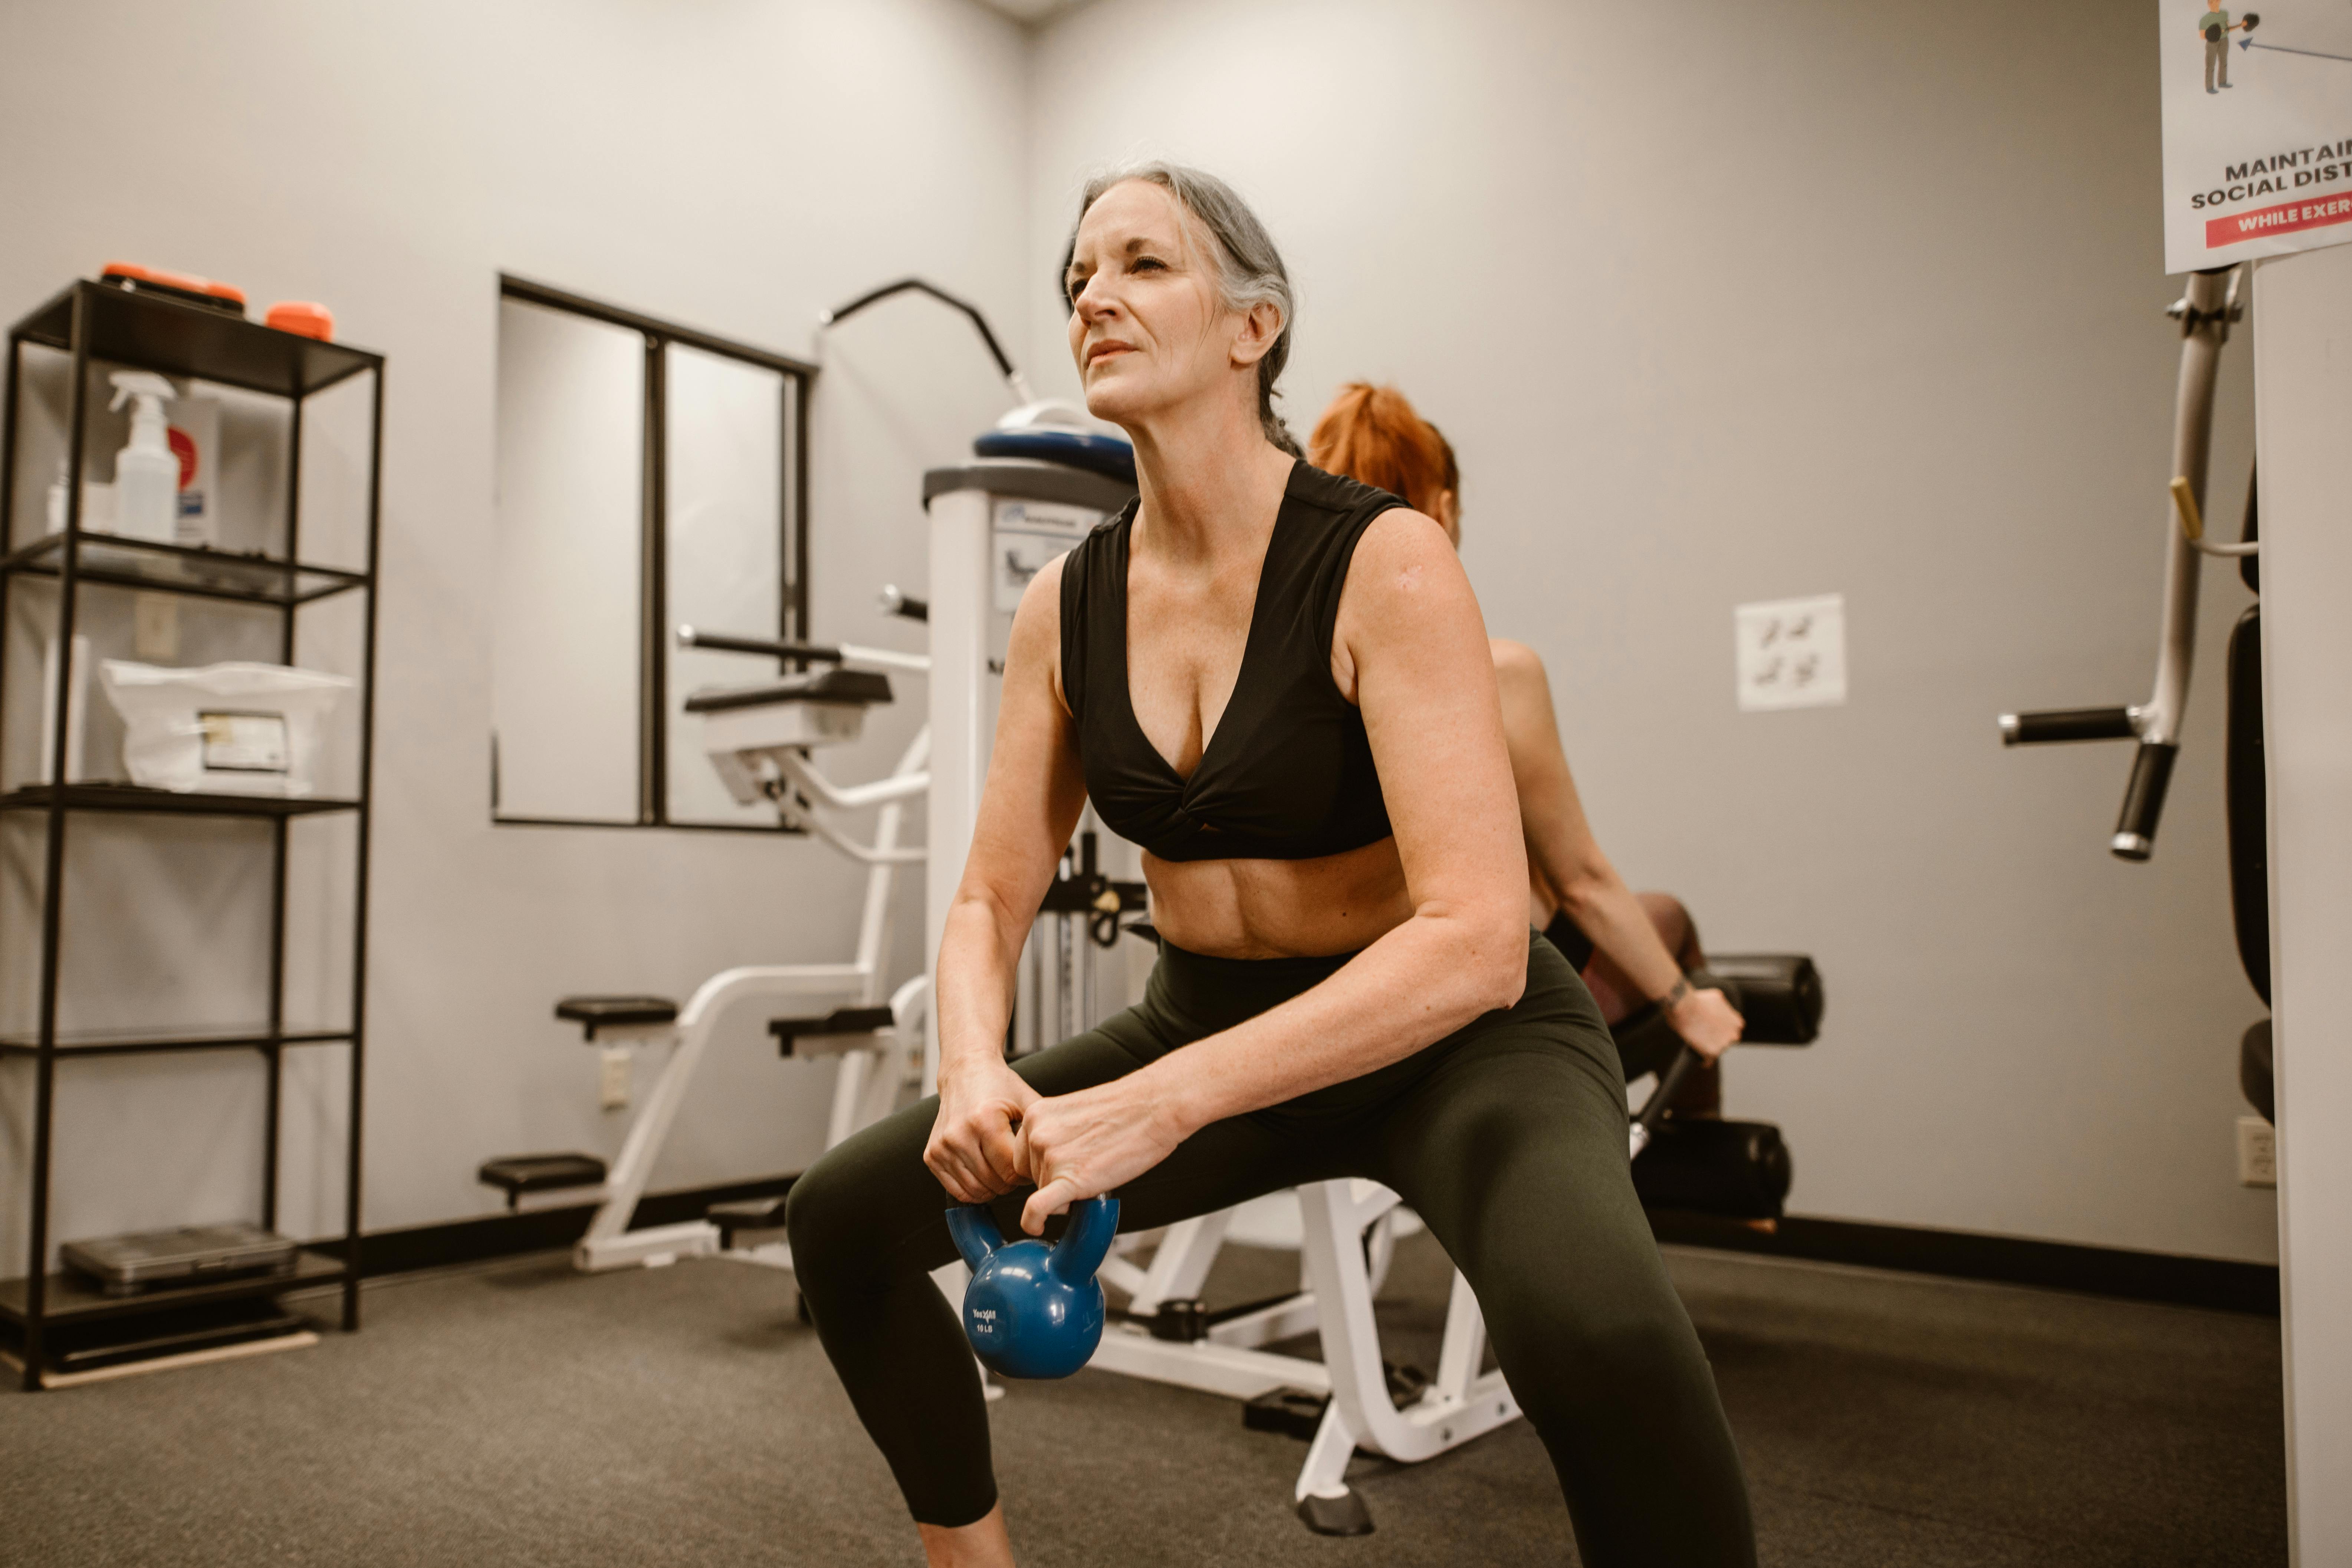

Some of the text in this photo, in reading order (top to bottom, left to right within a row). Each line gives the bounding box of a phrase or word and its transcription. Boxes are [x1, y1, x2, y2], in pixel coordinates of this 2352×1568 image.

[2191, 161, 2352, 209] SOCIAL DIST
[2238, 199, 2352, 231] WHILE EXER
[977, 1324, 992, 1333] 10 LB
